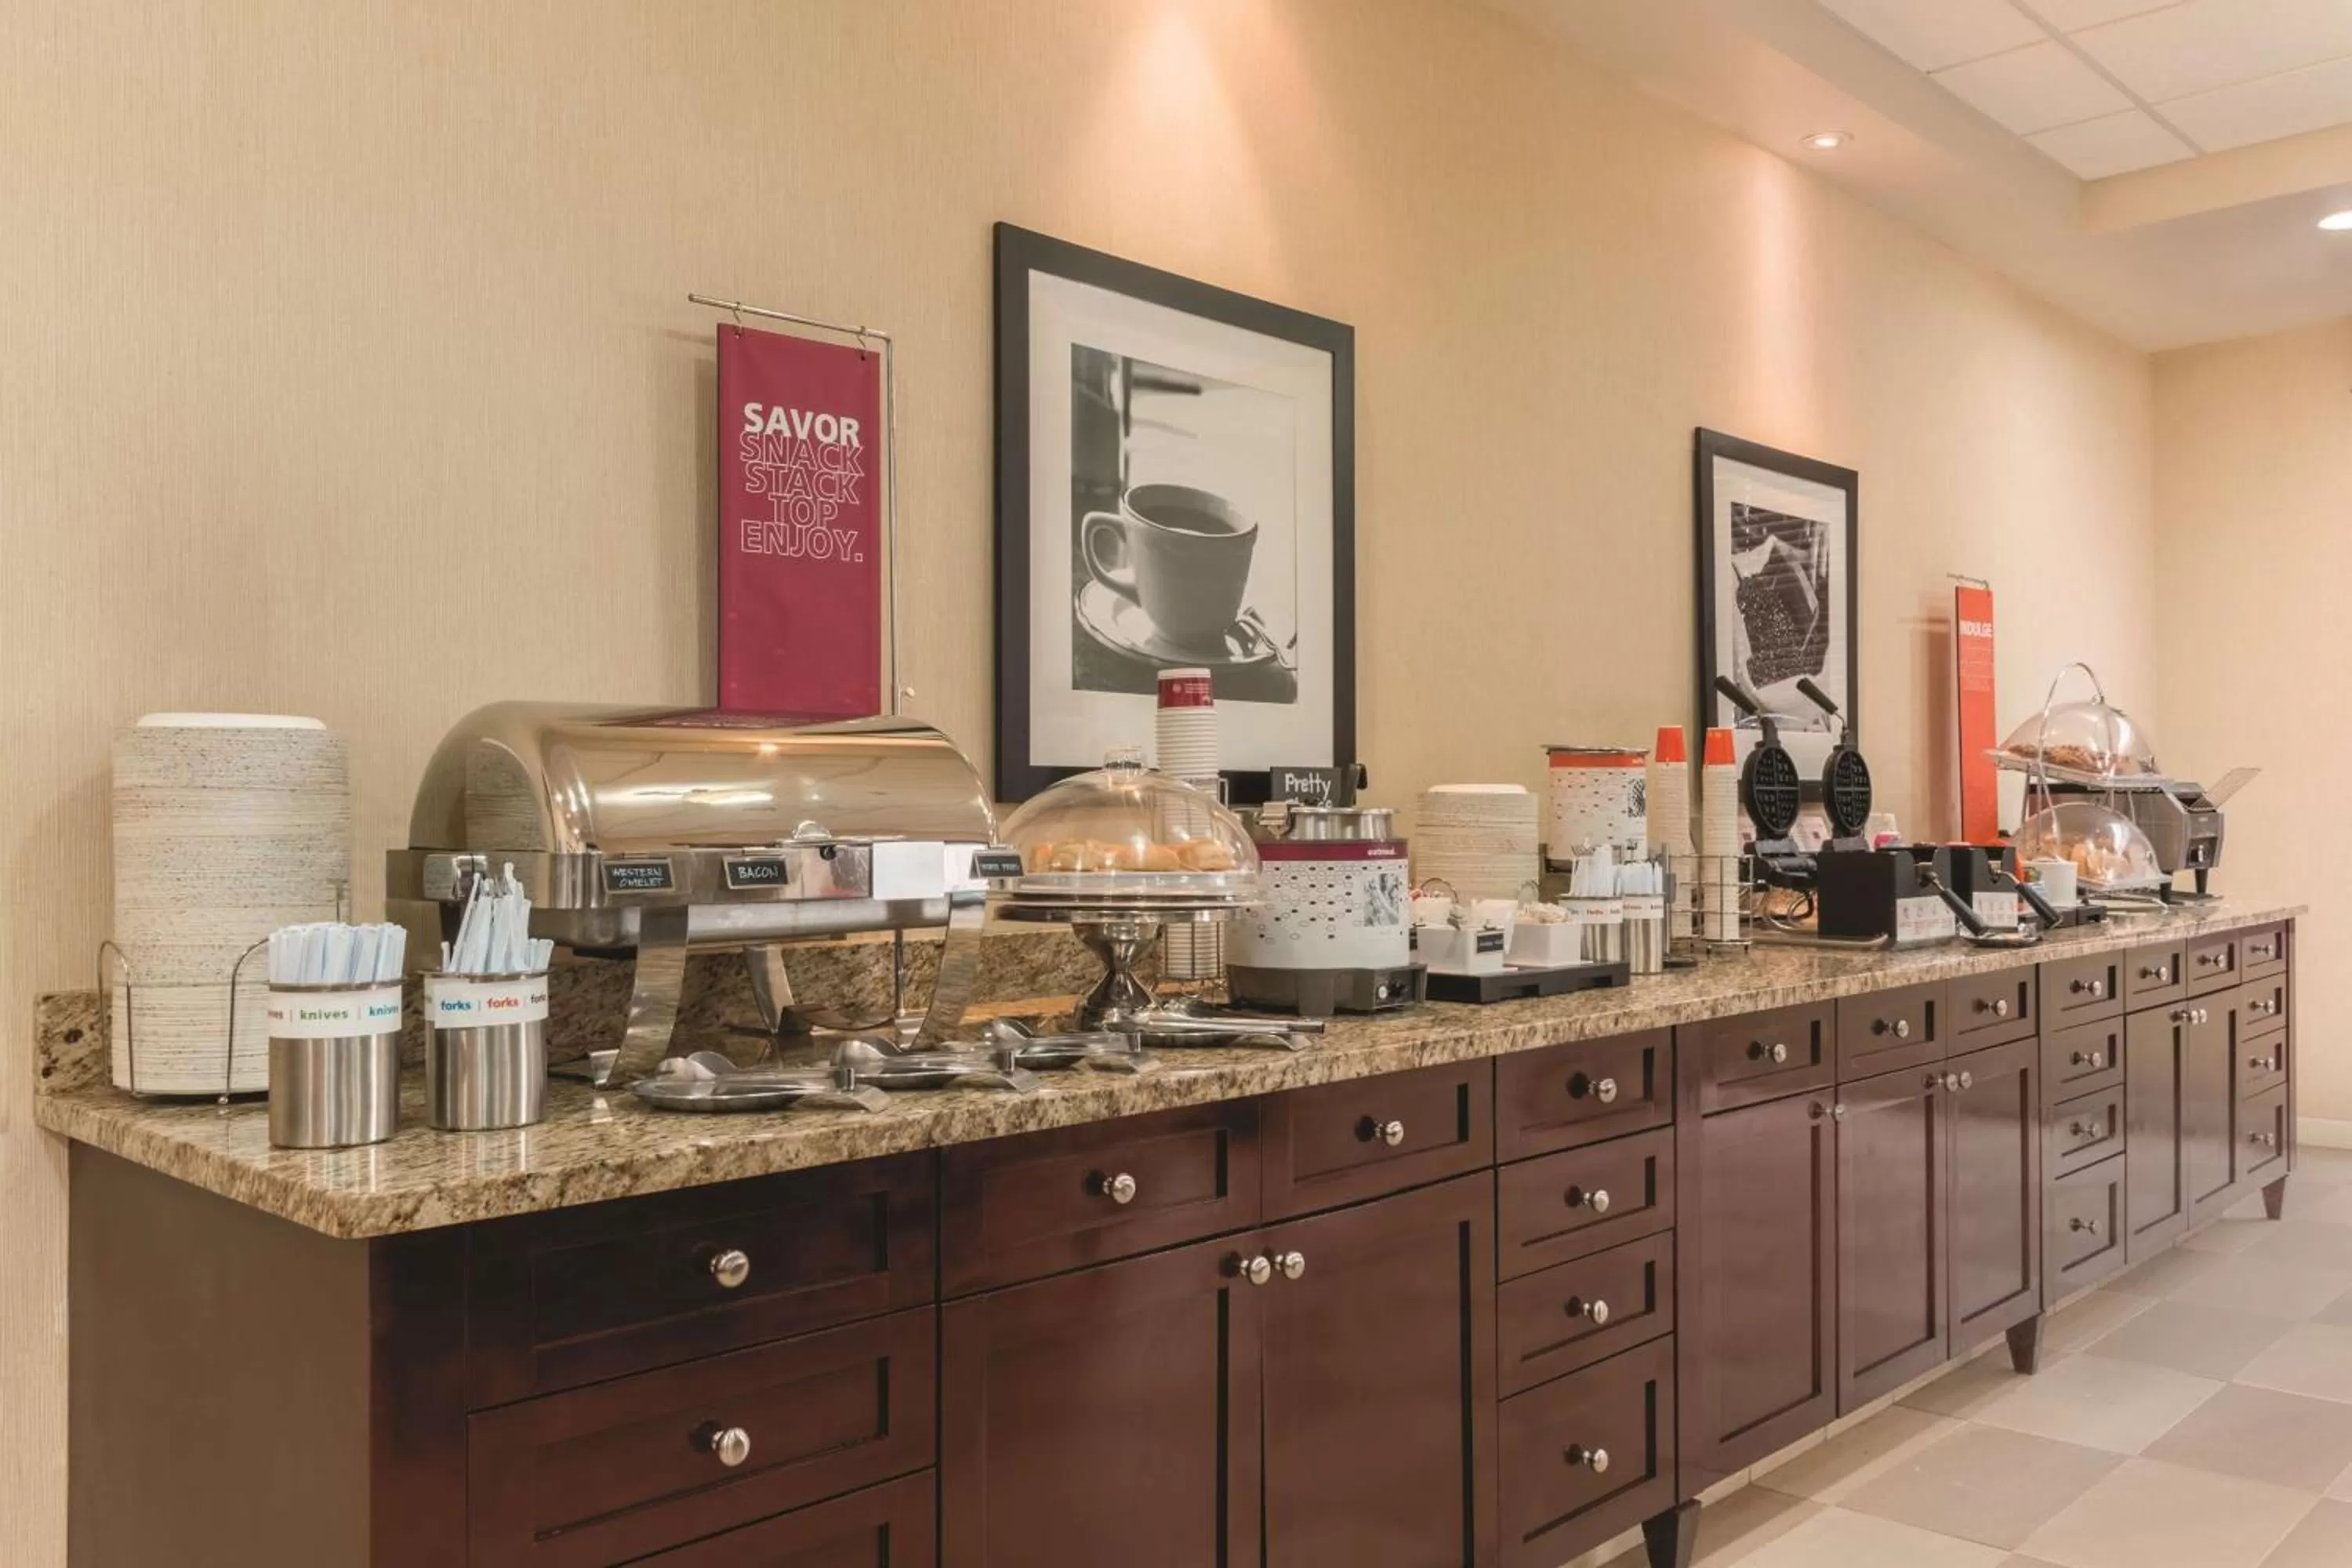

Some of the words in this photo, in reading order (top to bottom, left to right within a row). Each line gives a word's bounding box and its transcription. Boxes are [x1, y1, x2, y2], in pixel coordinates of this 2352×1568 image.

[744, 402, 859, 448] SAVOR
[740, 430, 864, 477] SNACK
[746, 460, 859, 505] STACK
[768, 492, 838, 530] TOP
[741, 519, 863, 562] ENJOY.
[1285, 771, 1332, 802] Pretty
[612, 866, 662, 877] WESTERN
[738, 865, 779, 879] BACON
[300, 1008, 349, 1020] knives
[441, 998, 471, 1011] forks
[487, 996, 519, 1009] forks
